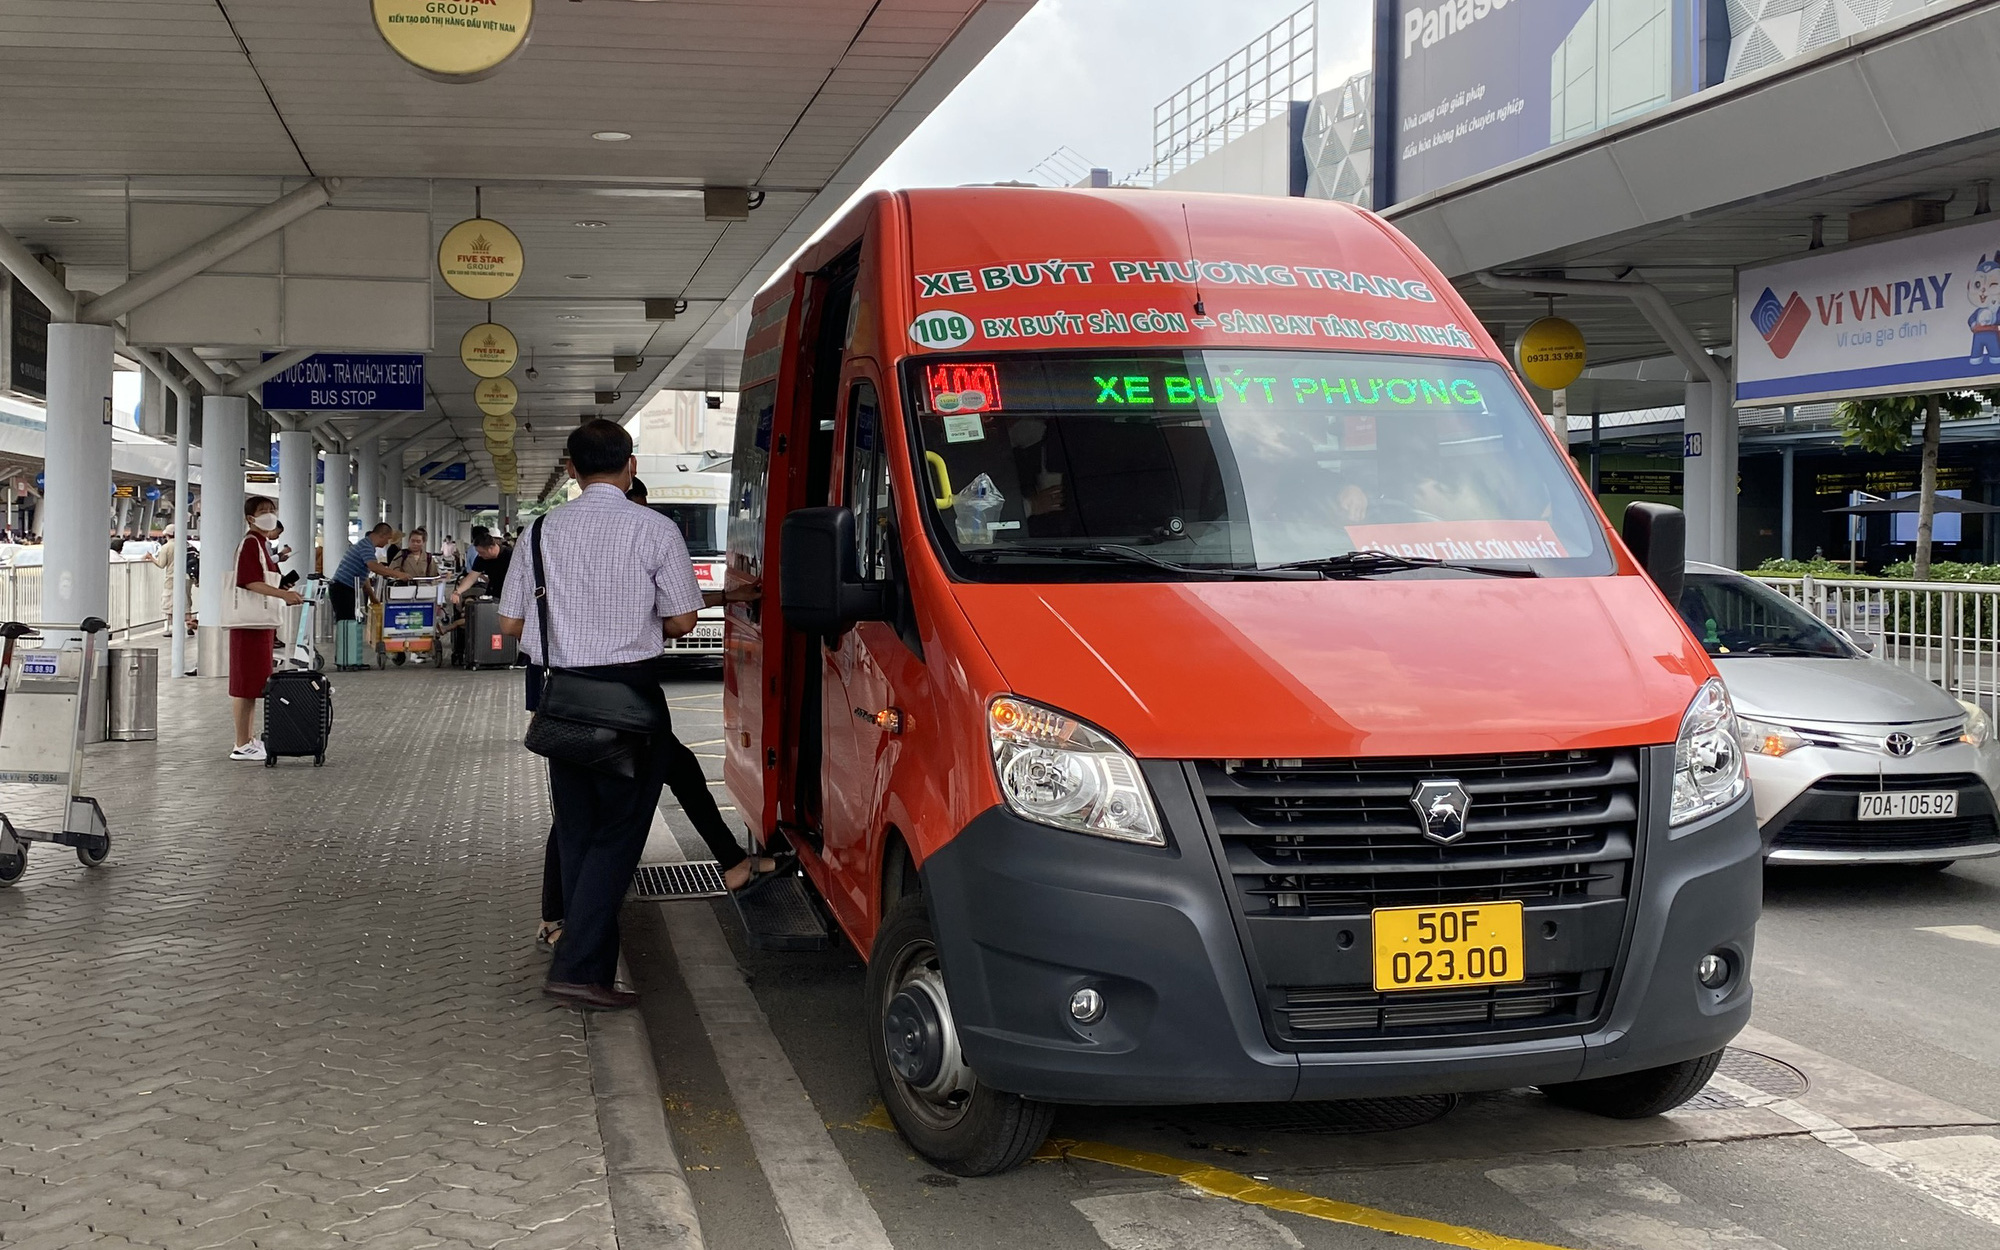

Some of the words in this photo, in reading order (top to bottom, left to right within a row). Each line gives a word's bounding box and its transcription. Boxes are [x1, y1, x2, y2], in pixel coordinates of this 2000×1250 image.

[425, 2, 479, 16] GROUP
[405, 15, 419, 25] TẠO
[431, 16, 444, 28] THỊ
[444, 17, 465, 27] HÀNG
[482, 20, 498, 32] VIỆT
[499, 23, 516, 33] NAM
[1404, 0, 1514, 59] Panas
[1418, 107, 1435, 125] cung
[1465, 83, 1486, 106] pháp
[1468, 110, 1495, 132] chuyên
[457, 255, 478, 263] FIVE
[479, 256, 504, 264] STAR
[918, 272, 976, 298] XE
[980, 260, 1094, 293] BUÝT
[1112, 260, 1299, 287] PHƯƠNG
[1293, 266, 1437, 303] TRANG
[1816, 291, 1844, 326] Ví
[1849, 273, 1952, 322] VNPAY
[916, 316, 967, 342] 109
[981, 317, 1017, 339] BX
[1020, 311, 1083, 337] BUÝT
[1088, 309, 1129, 334] SÀI
[1131, 308, 1189, 333] GÒN
[1217, 309, 1273, 334] SÂN
[1271, 312, 1315, 337] BAY
[1315, 313, 1367, 339] TÂN
[1368, 321, 1418, 343] SƠN
[1415, 323, 1477, 349] NHẤT
[1876, 325, 1894, 347] gia
[306, 359, 326, 383] ĐÓN
[352, 360, 383, 383] KHÁCH
[384, 364, 397, 384] XE
[399, 360, 422, 384] BUÝT
[311, 390, 338, 405] BUS
[341, 390, 377, 405] STOP
[1094, 376, 1154, 404] XE
[1164, 369, 1278, 404] BUÝT
[1291, 376, 1482, 405] PHƯƠNG
[1684, 434, 1701, 456] -18
[649, 488, 727, 498] RESIDEN
[1436, 538, 1475, 560] TÂN
[1475, 538, 1513, 559] SƠN
[1512, 534, 1563, 559] NHẤT
[28, 773, 39, 782] SG
[1862, 794, 1954, 816] 70A-105.92
[1418, 910, 1480, 944] 50F
[1393, 946, 1507, 984] 023.00
